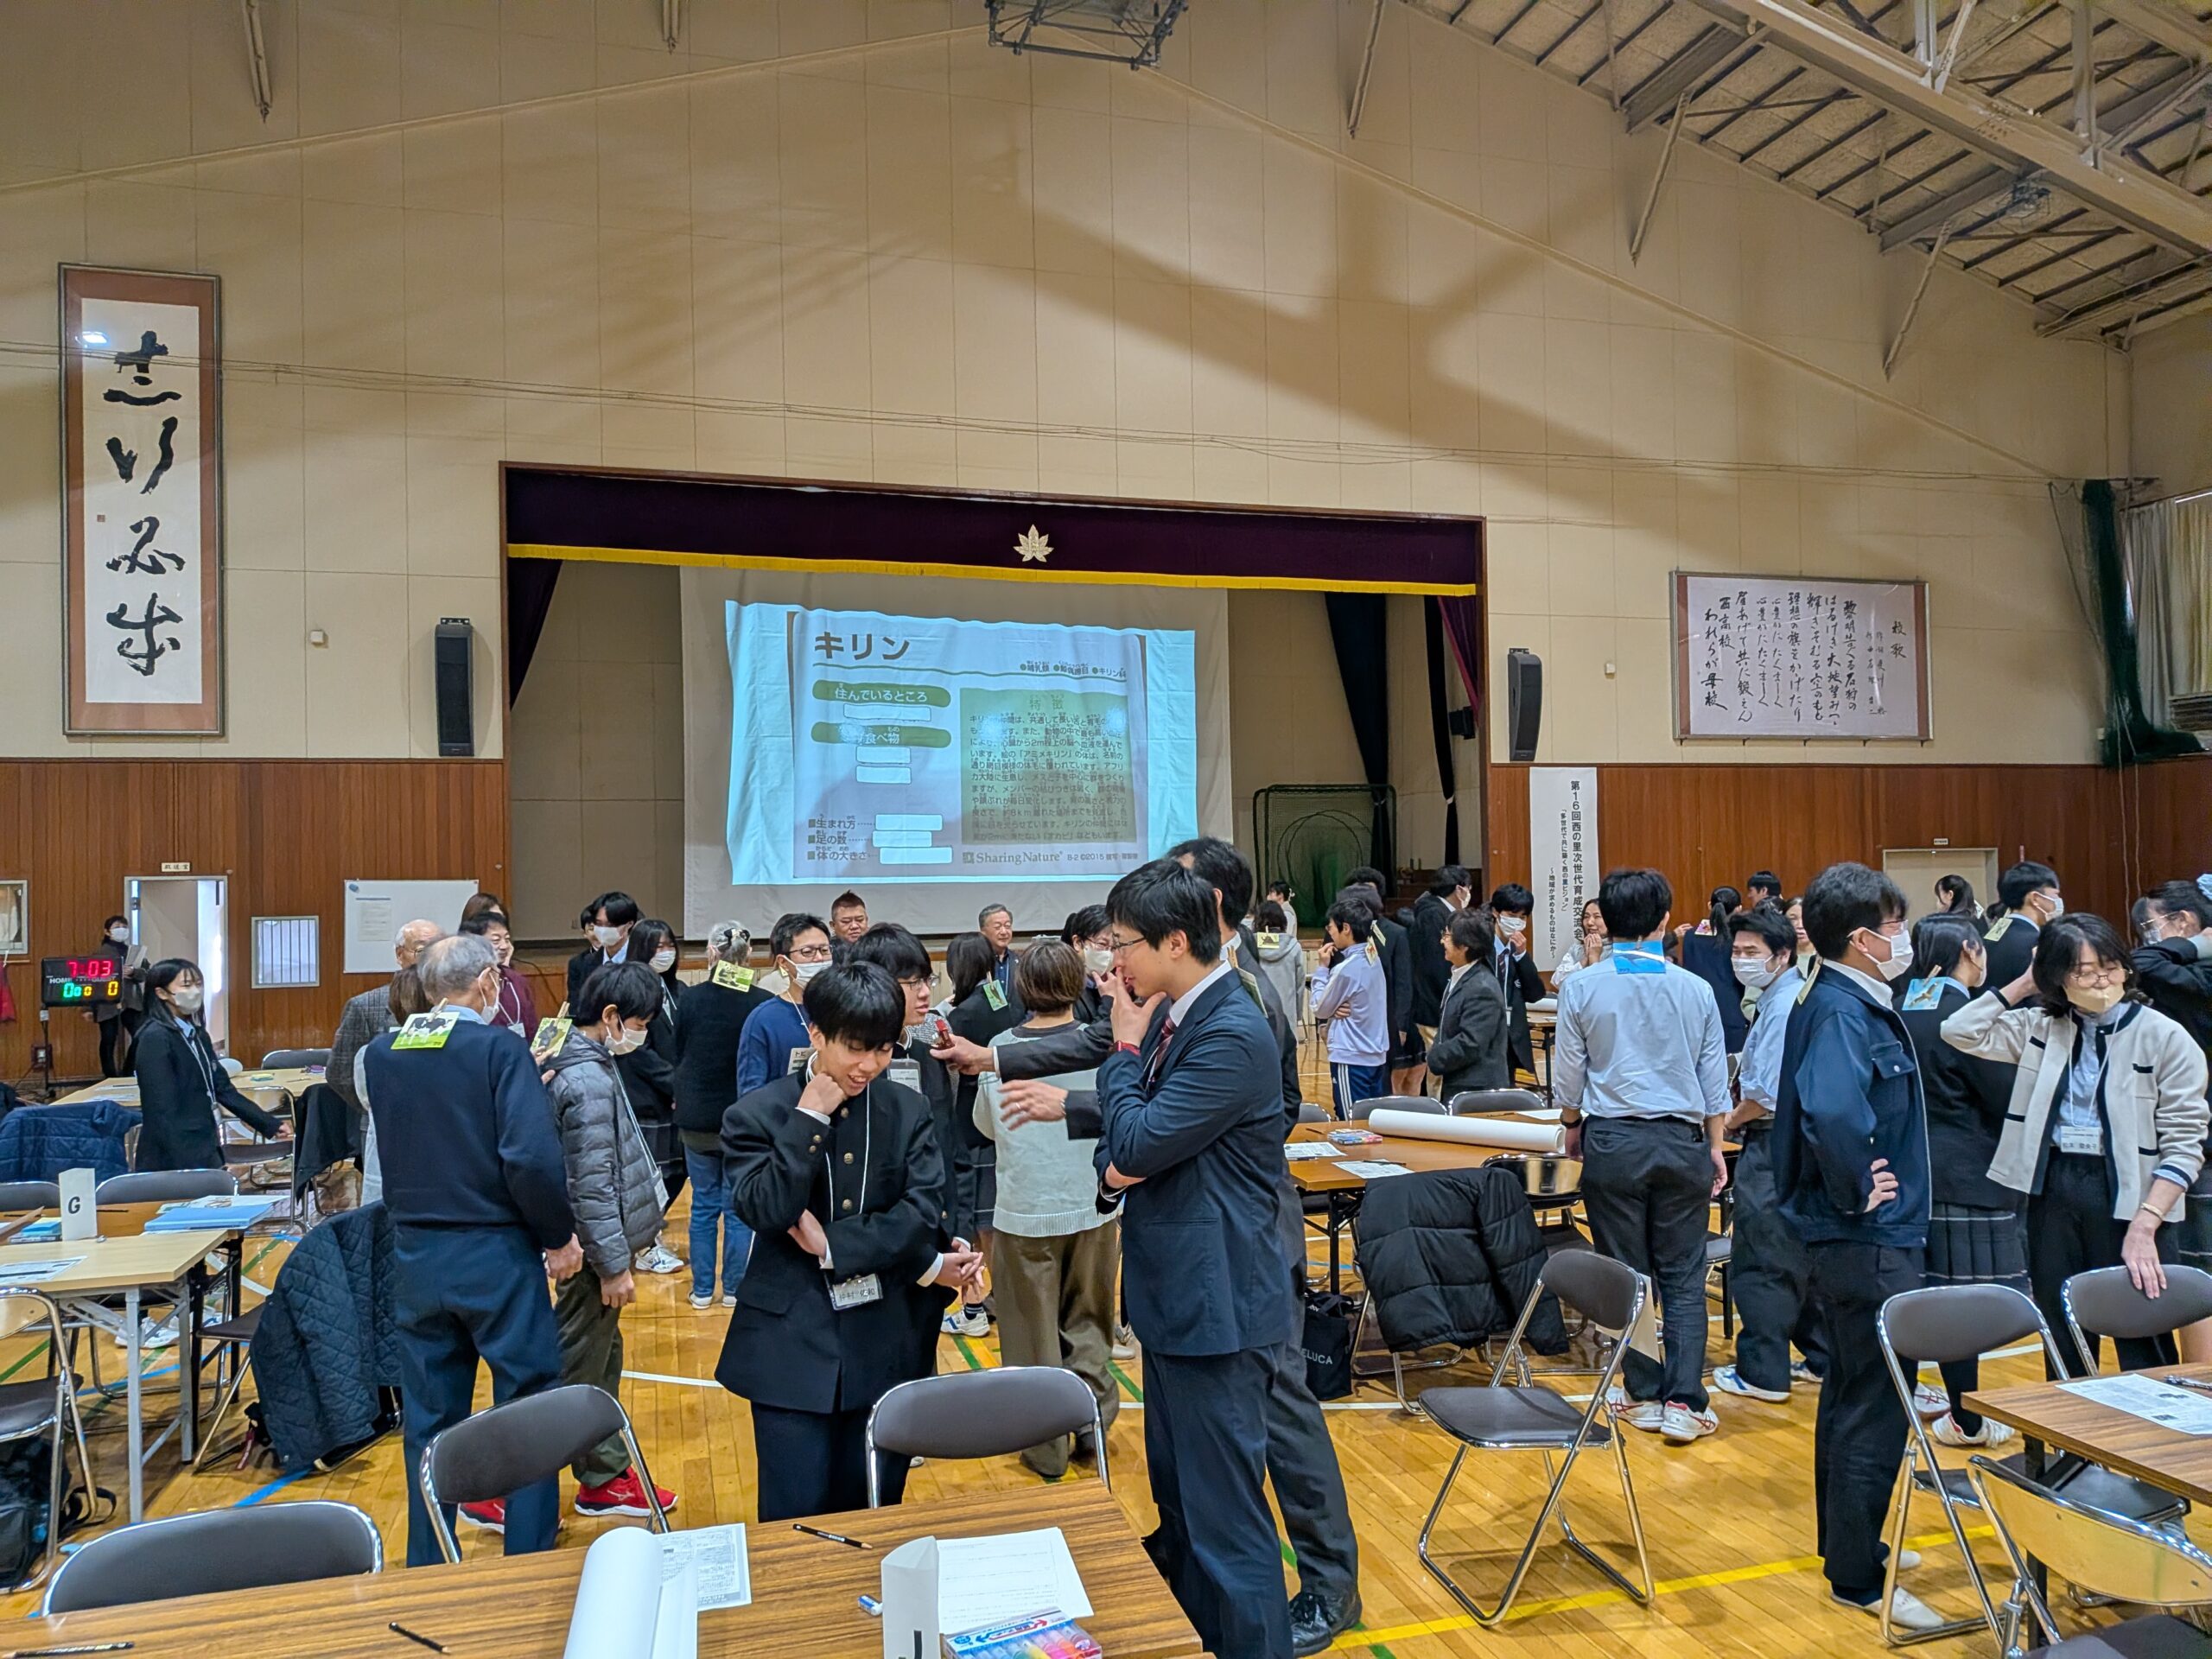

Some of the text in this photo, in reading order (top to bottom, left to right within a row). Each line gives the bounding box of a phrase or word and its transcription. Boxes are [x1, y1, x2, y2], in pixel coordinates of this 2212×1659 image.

[1719, 596, 1735, 650] 西高校
[814, 631, 911, 661] キリン
[1700, 607, 1728, 711] われらが母校
[835, 687, 927, 702] 住んでいるところ
[816, 819, 856, 830] 生まれ方
[816, 835, 848, 845] 足の数
[817, 851, 867, 861] 体の大きさ
[67, 960, 112, 978] 7:03
[67, 1196, 81, 1214] G
